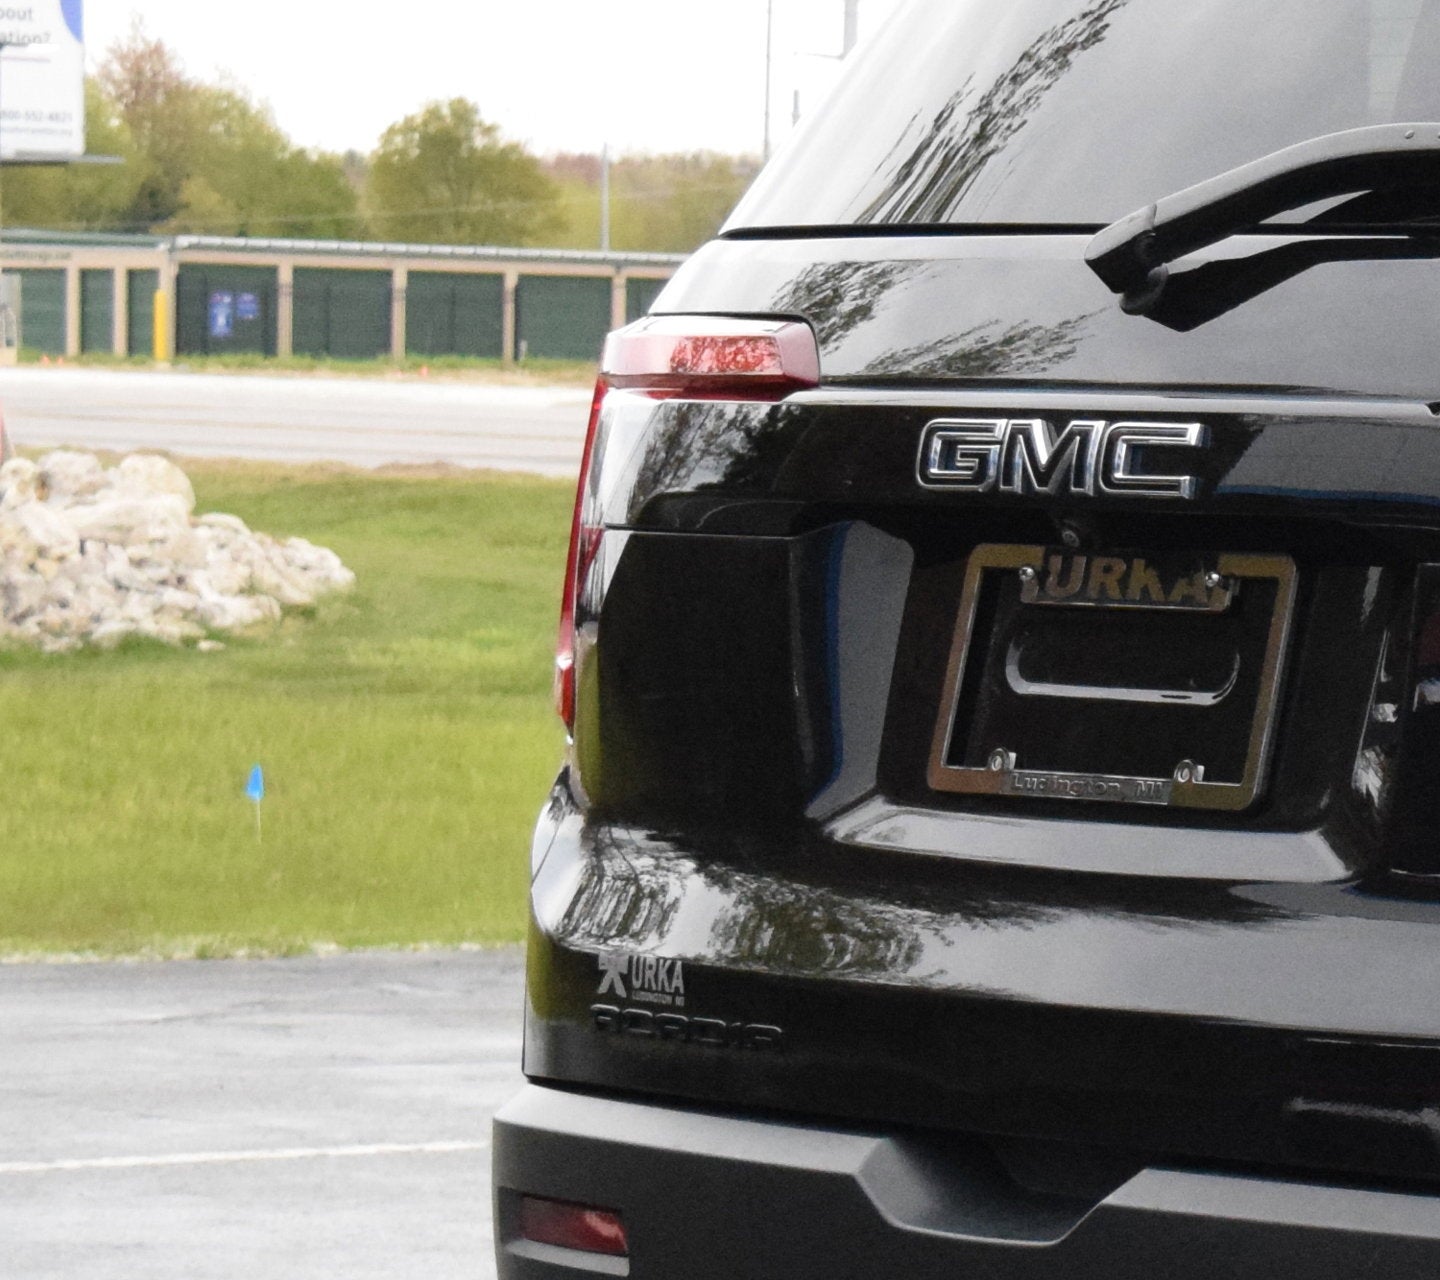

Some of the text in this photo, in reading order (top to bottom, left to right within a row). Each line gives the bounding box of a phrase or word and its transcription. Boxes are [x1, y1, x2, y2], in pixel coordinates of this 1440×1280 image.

[916, 418, 1211, 499] GMC
[1045, 555, 1210, 604] URKA
[631, 955, 686, 994] URKA
